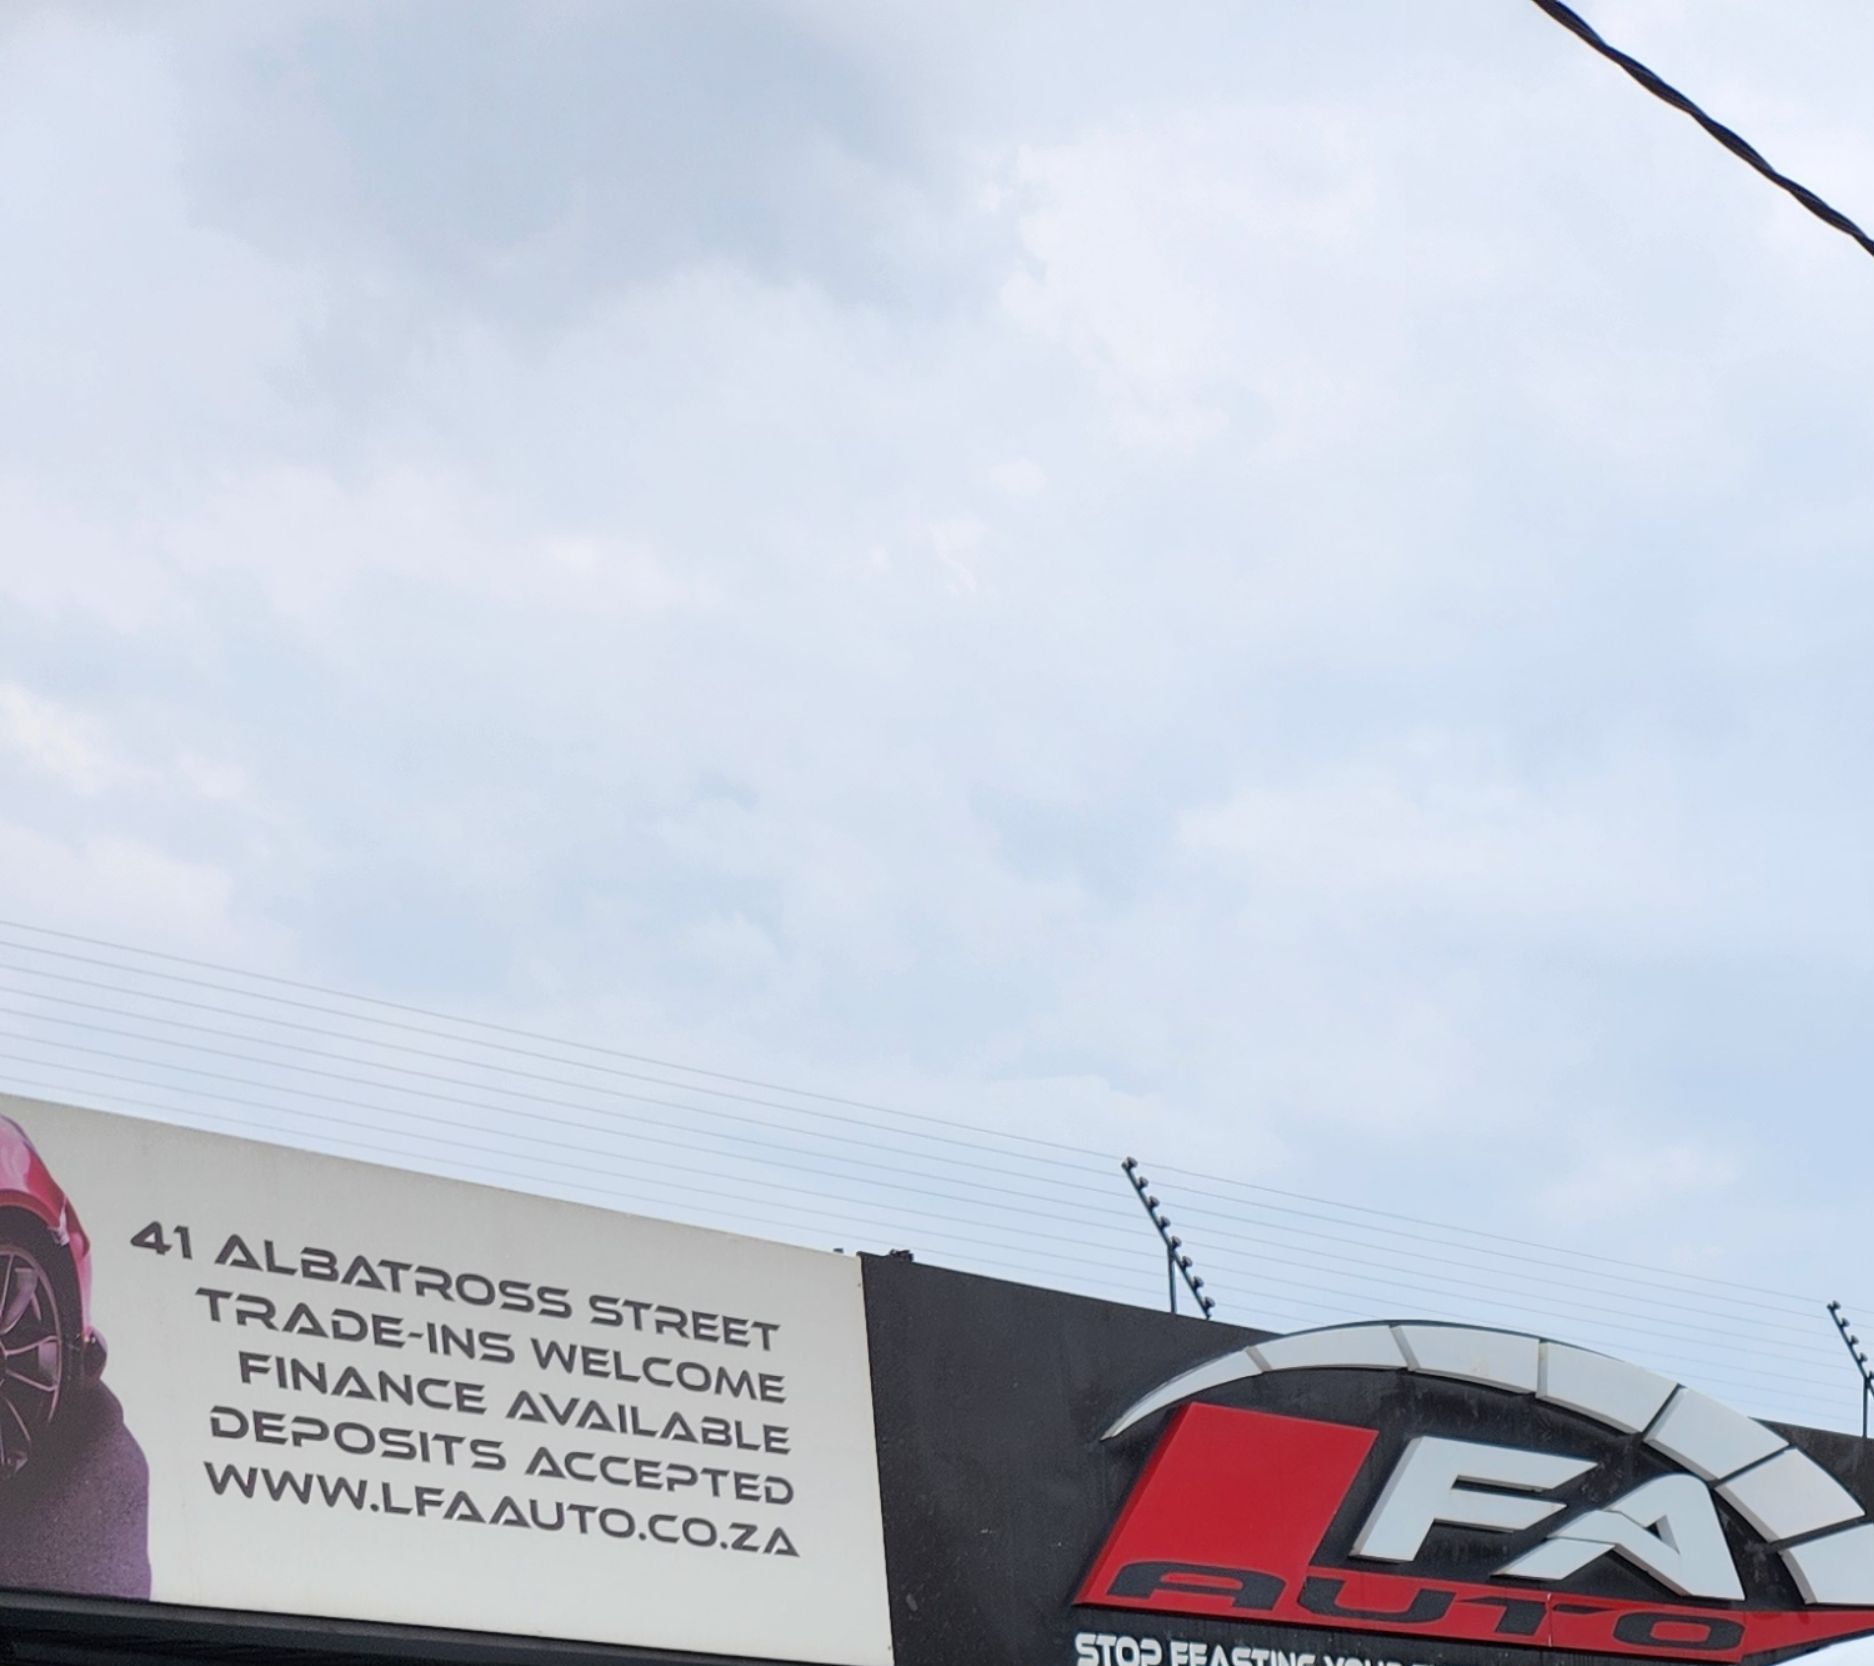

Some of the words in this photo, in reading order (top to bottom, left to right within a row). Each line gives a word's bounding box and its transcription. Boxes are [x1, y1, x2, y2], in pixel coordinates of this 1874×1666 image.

[130, 1221, 193, 1260] 41
[214, 1234, 572, 1319] ALBATROSS
[588, 1295, 780, 1351] STREET
[195, 1287, 515, 1364] TRADE-INS
[530, 1337, 787, 1404] WELCOME
[238, 1351, 488, 1415] FINANCE
[505, 1390, 791, 1455] AVAILABLE
[211, 1405, 506, 1471] DEPOSITS
[525, 1446, 794, 1506] ACCEPTED
[203, 1461, 800, 1557] WWW.LFAAUTO.CO.ZA
[1107, 1561, 1746, 1653] AUTO
